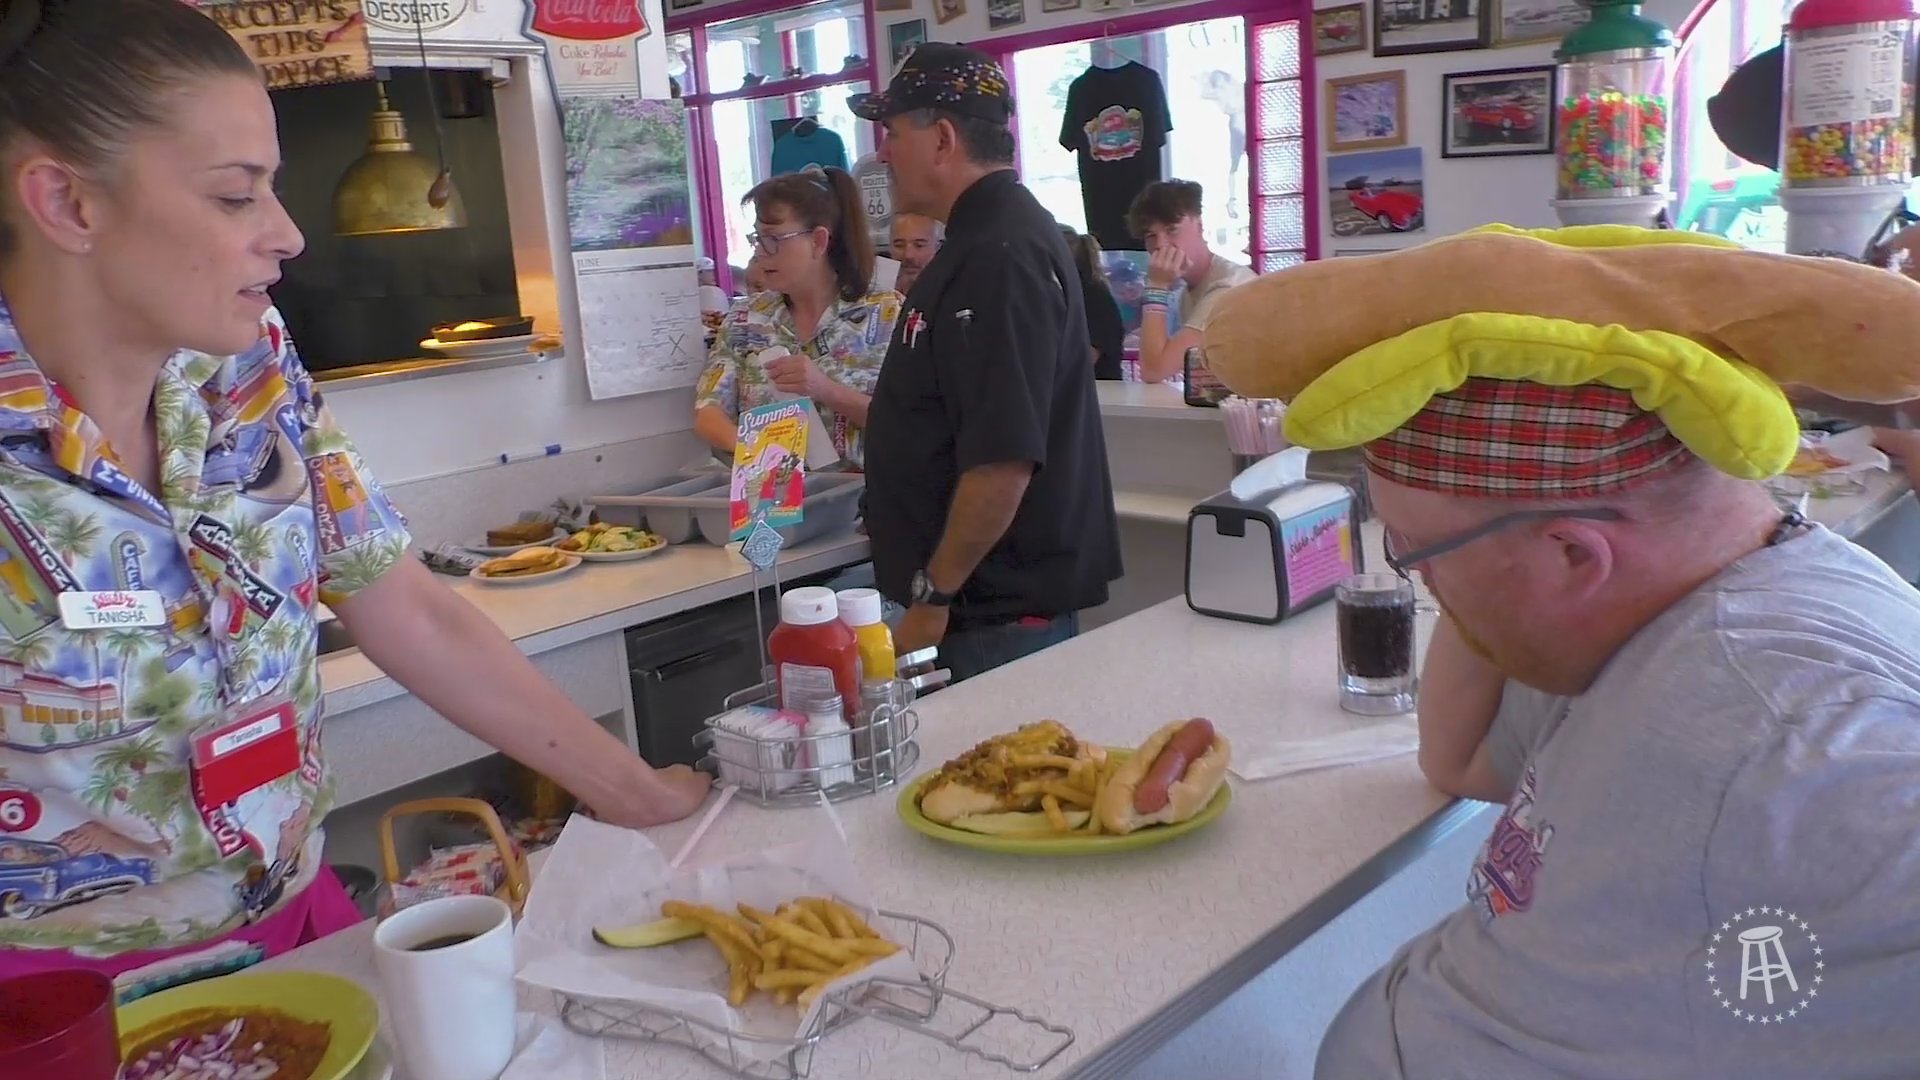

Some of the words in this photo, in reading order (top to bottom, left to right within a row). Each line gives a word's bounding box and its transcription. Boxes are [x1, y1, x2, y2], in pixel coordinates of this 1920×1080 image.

[211, 1, 348, 30] ACCEPTS
[366, 1, 450, 23] DESSERTS
[249, 29, 326, 58] TIPS
[560, 45, 590, 59] Coke
[868, 198, 885, 215] 66
[578, 258, 600, 268] JUNE
[738, 402, 801, 437] Summer
[88, 610, 147, 624] TANISHA
[230, 726, 263, 744] Tanisha
